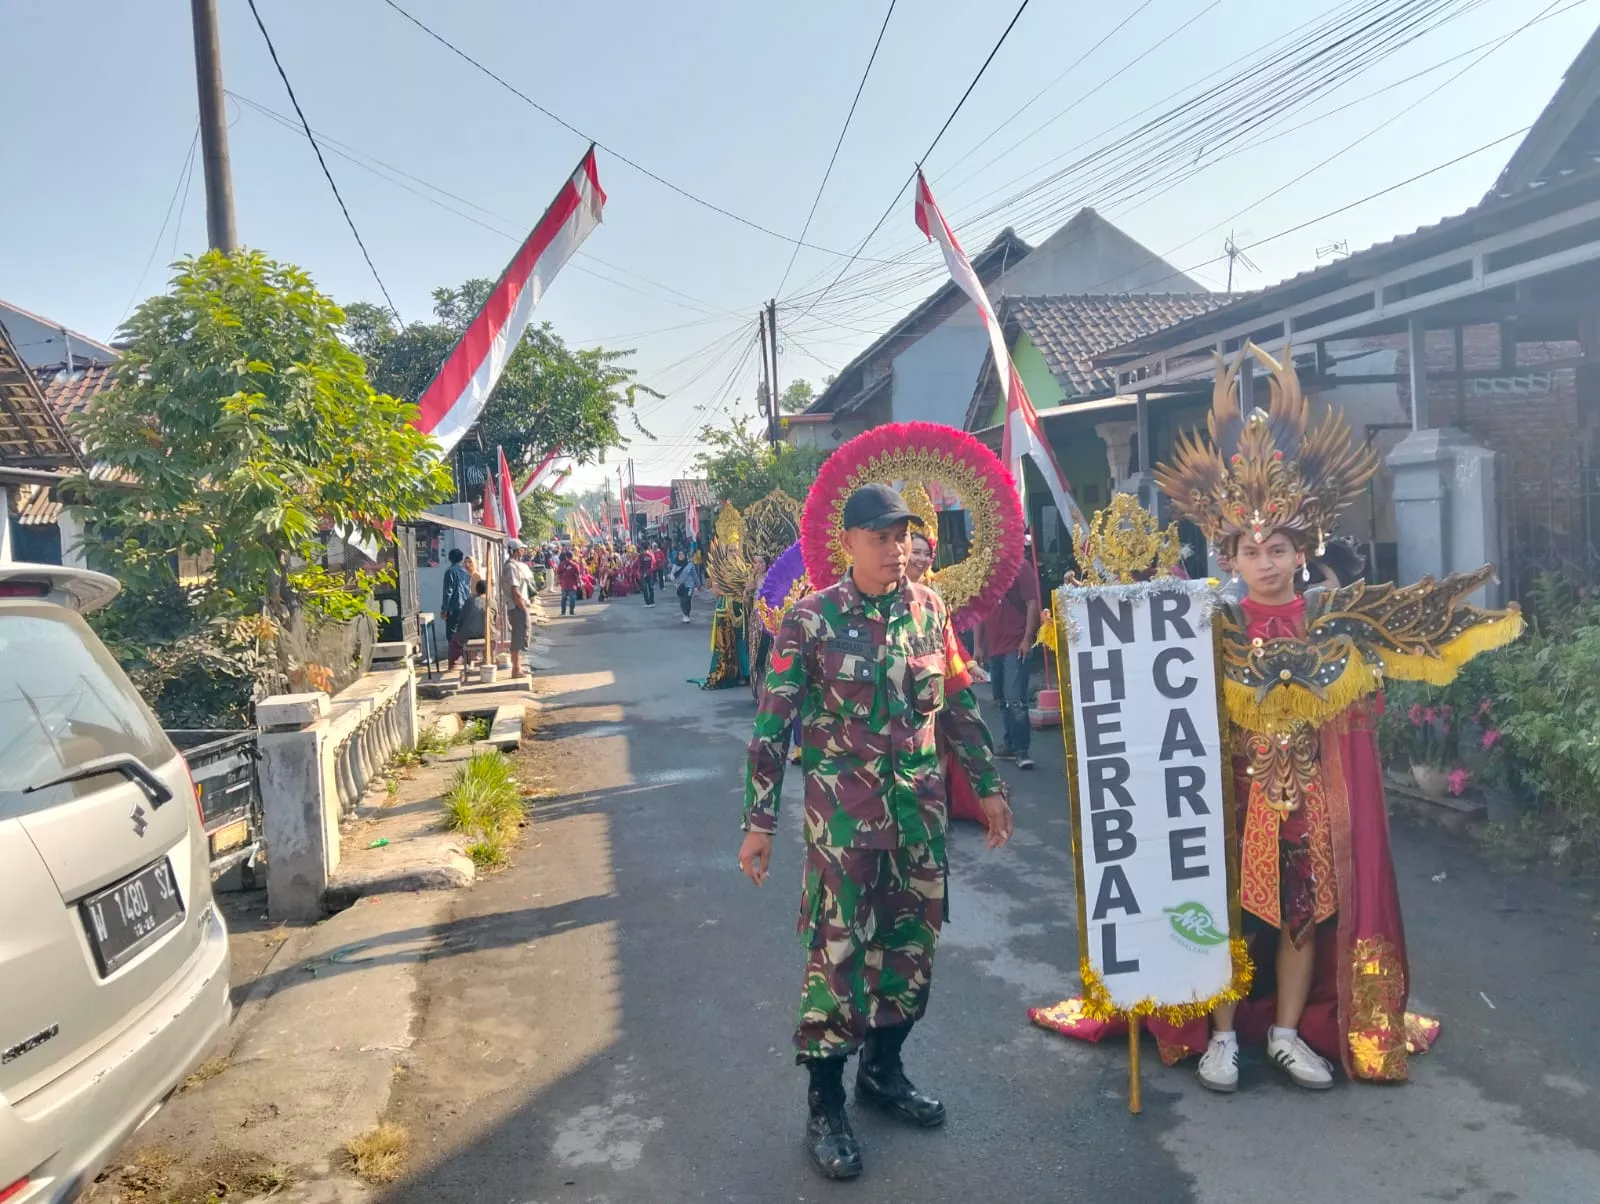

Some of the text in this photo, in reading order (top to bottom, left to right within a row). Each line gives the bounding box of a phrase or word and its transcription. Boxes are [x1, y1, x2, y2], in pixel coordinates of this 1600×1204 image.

[90, 863, 175, 942] W 1480 SZ
